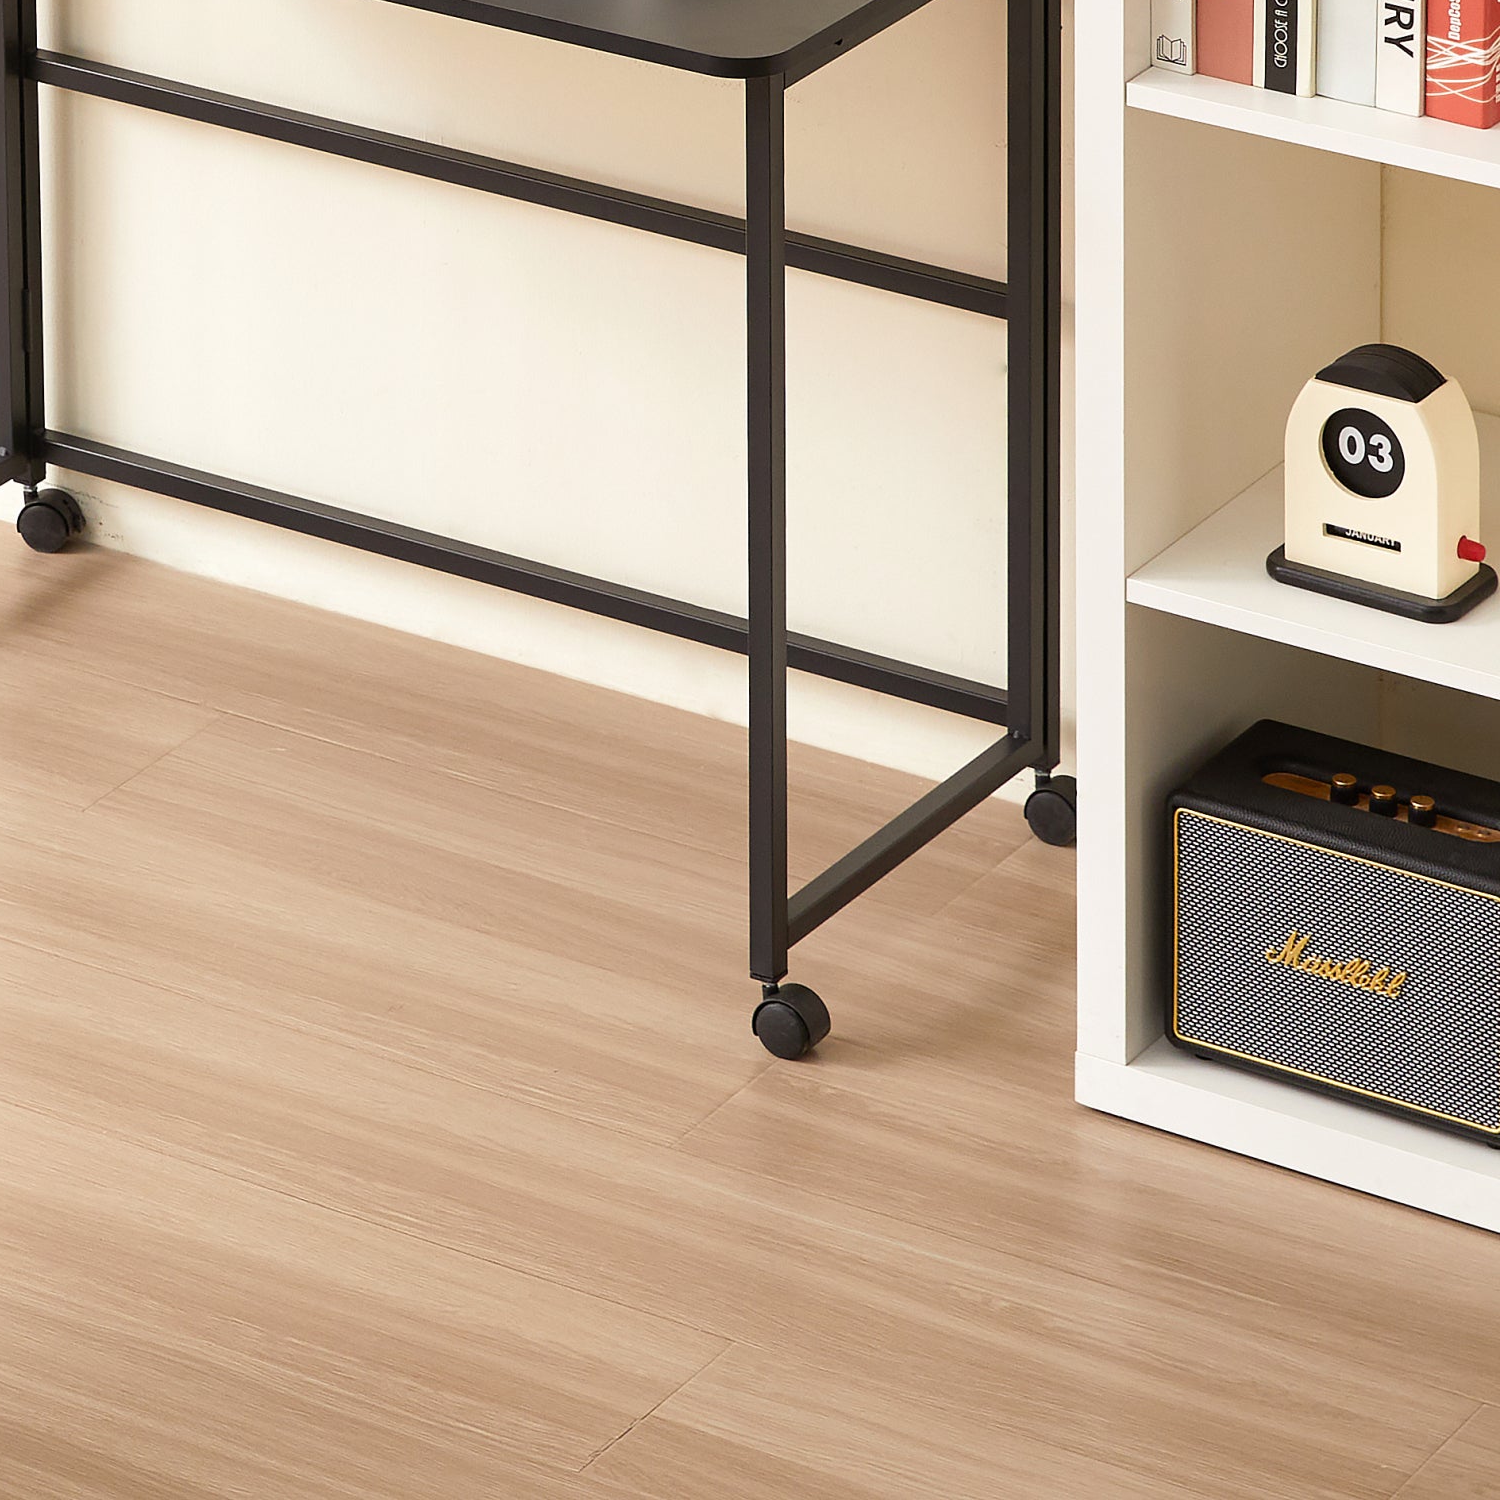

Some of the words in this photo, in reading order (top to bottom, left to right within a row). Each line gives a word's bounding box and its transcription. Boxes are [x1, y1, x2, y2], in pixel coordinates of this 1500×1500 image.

[1274, 9, 1288, 17] A
[1274, 19, 1288, 68] CHOOSE
[1338, 426, 1394, 473] 03
[1345, 529, 1396, 547] JANUARY
